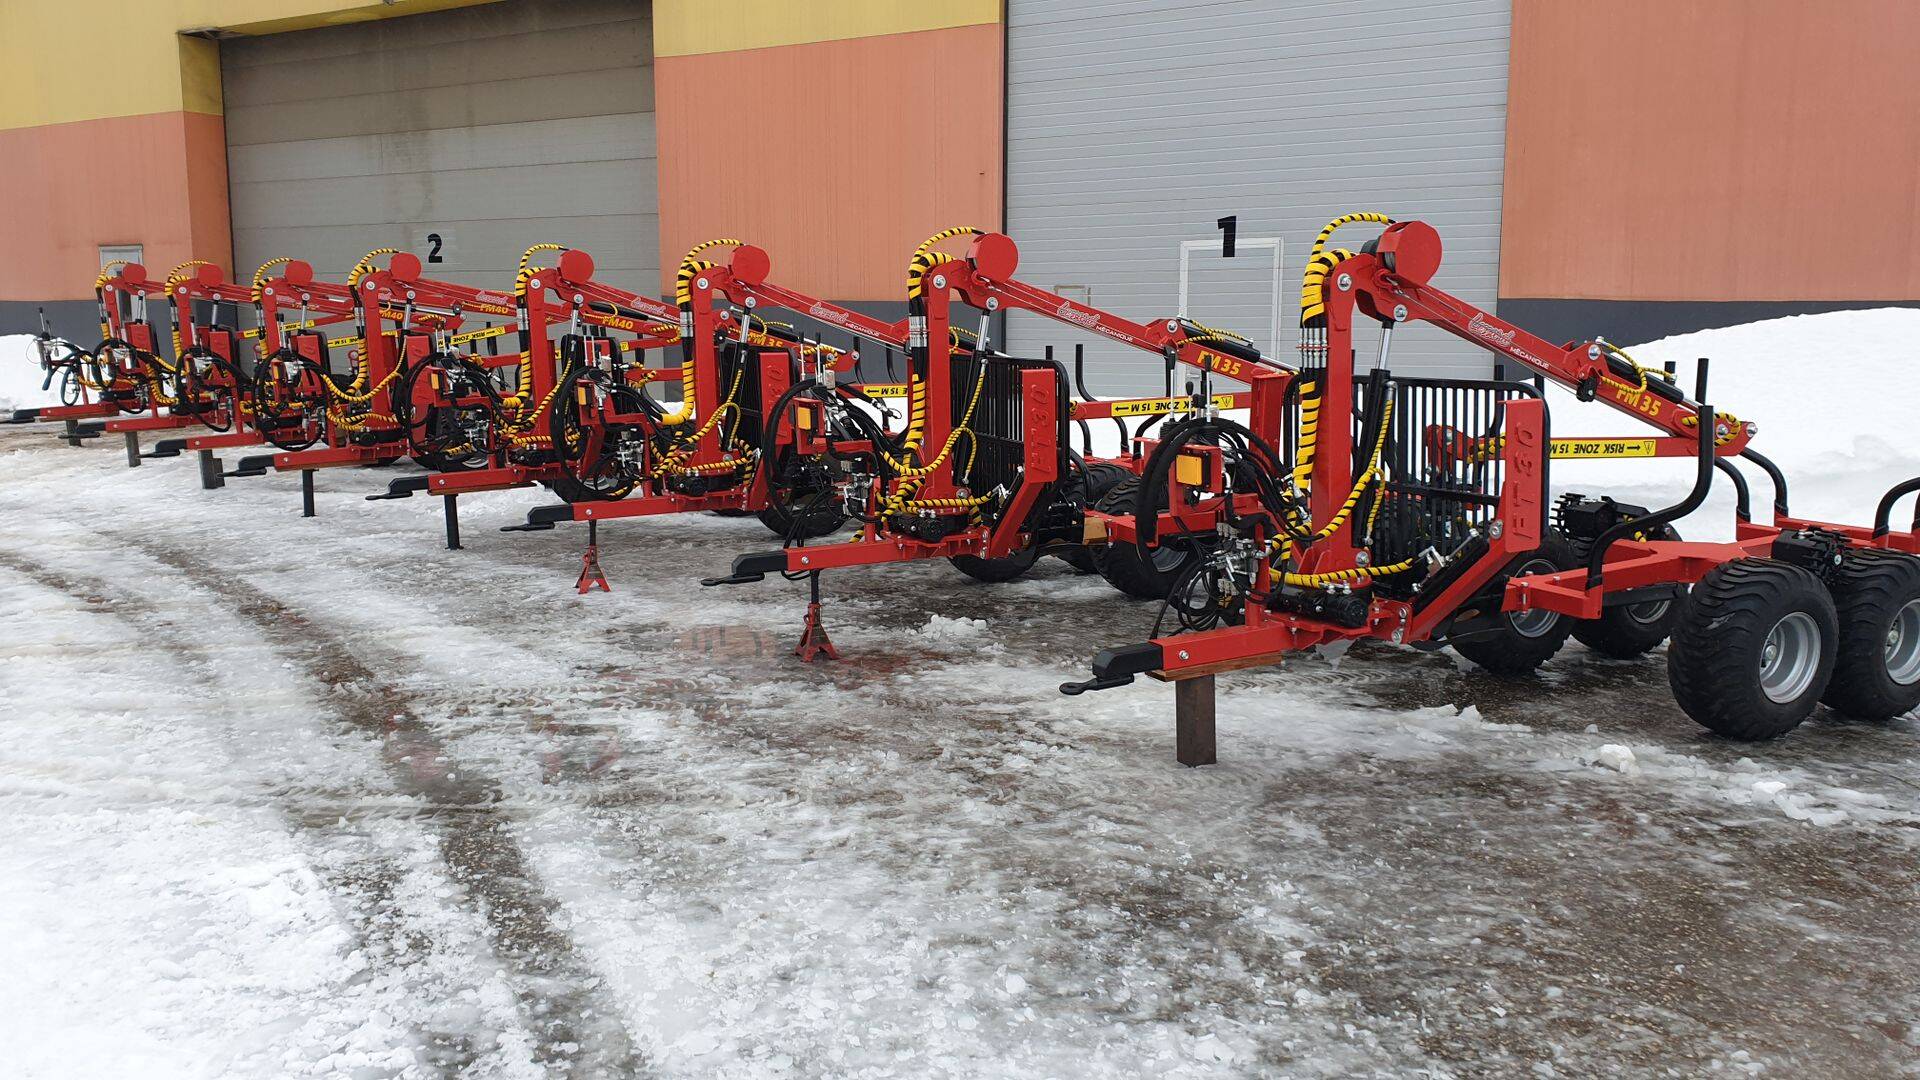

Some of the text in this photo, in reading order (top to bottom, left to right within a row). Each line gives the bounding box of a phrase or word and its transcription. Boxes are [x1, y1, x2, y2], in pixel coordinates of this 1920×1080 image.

[1217, 215, 1237, 258] 1
[427, 233, 443, 263] 2
[379, 310, 404, 321] M40
[602, 315, 635, 330] FM40
[1220, 358, 1242, 375] 35
[881, 387, 889, 395] M
[1130, 403, 1140, 412] M
[1141, 402, 1151, 411] 15
[1639, 394, 1662, 416] 35
[1559, 443, 1570, 454] 15
[1573, 443, 1600, 454] ZONE
[1603, 444, 1625, 454] RISK
